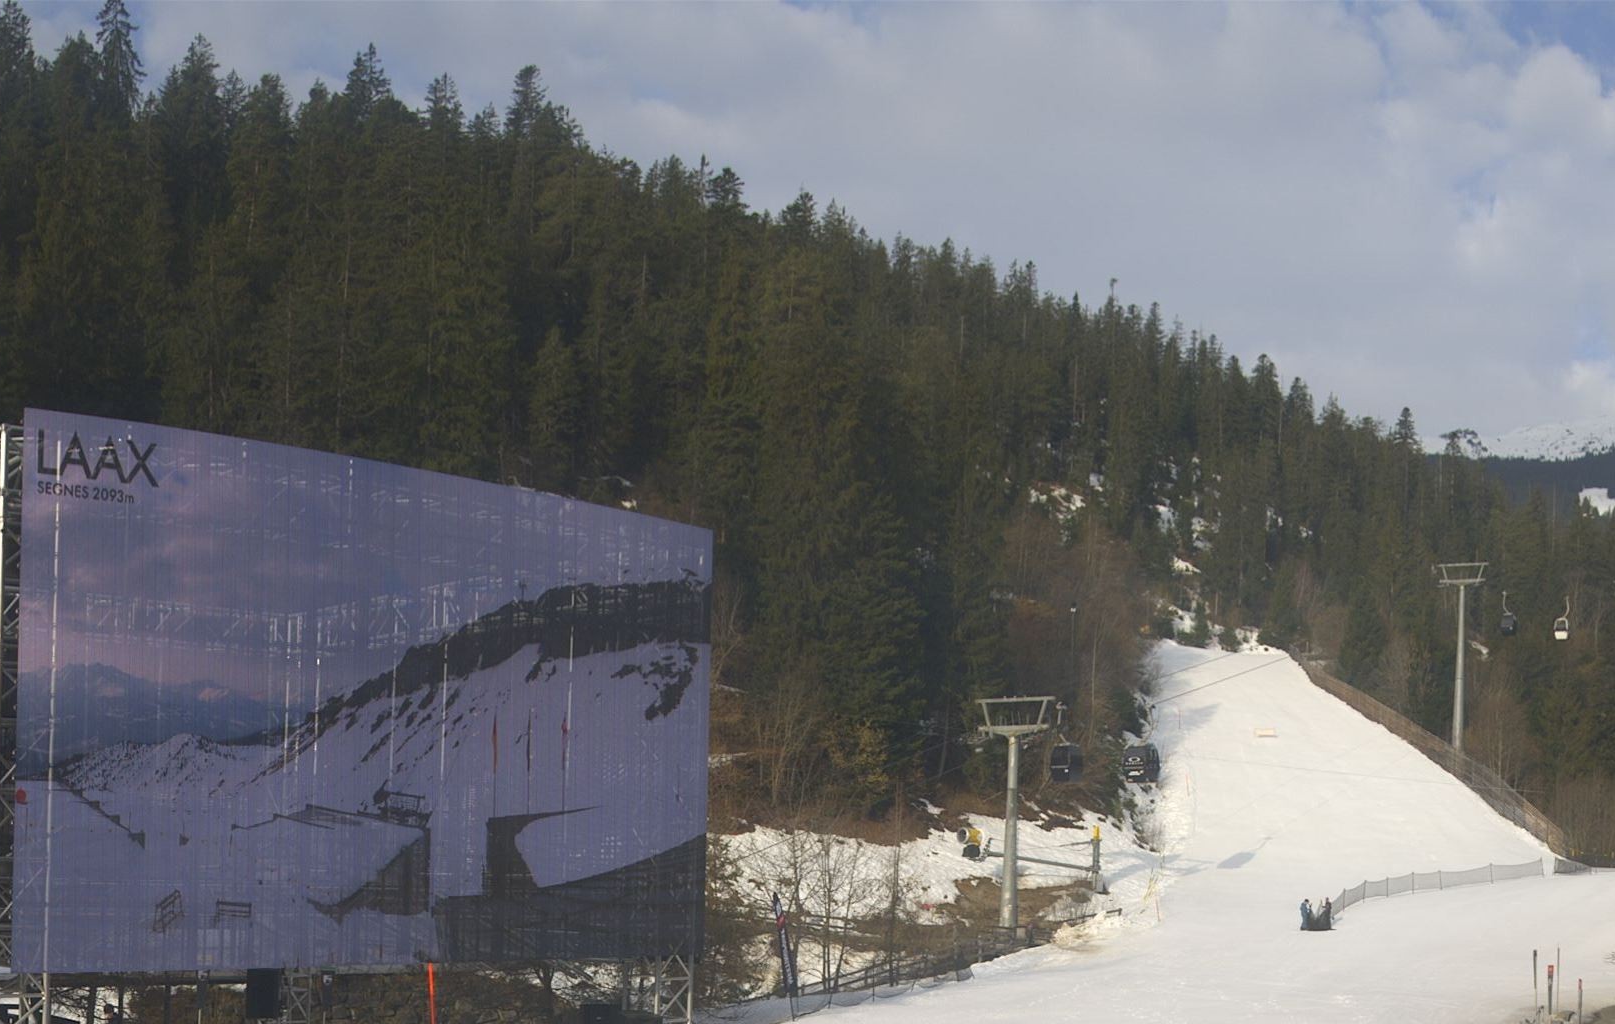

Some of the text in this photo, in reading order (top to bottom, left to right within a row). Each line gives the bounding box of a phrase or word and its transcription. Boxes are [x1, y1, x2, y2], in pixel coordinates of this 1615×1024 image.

[38, 429, 159, 487] LAAX
[37, 481, 135, 504] SEGNES 2093m
